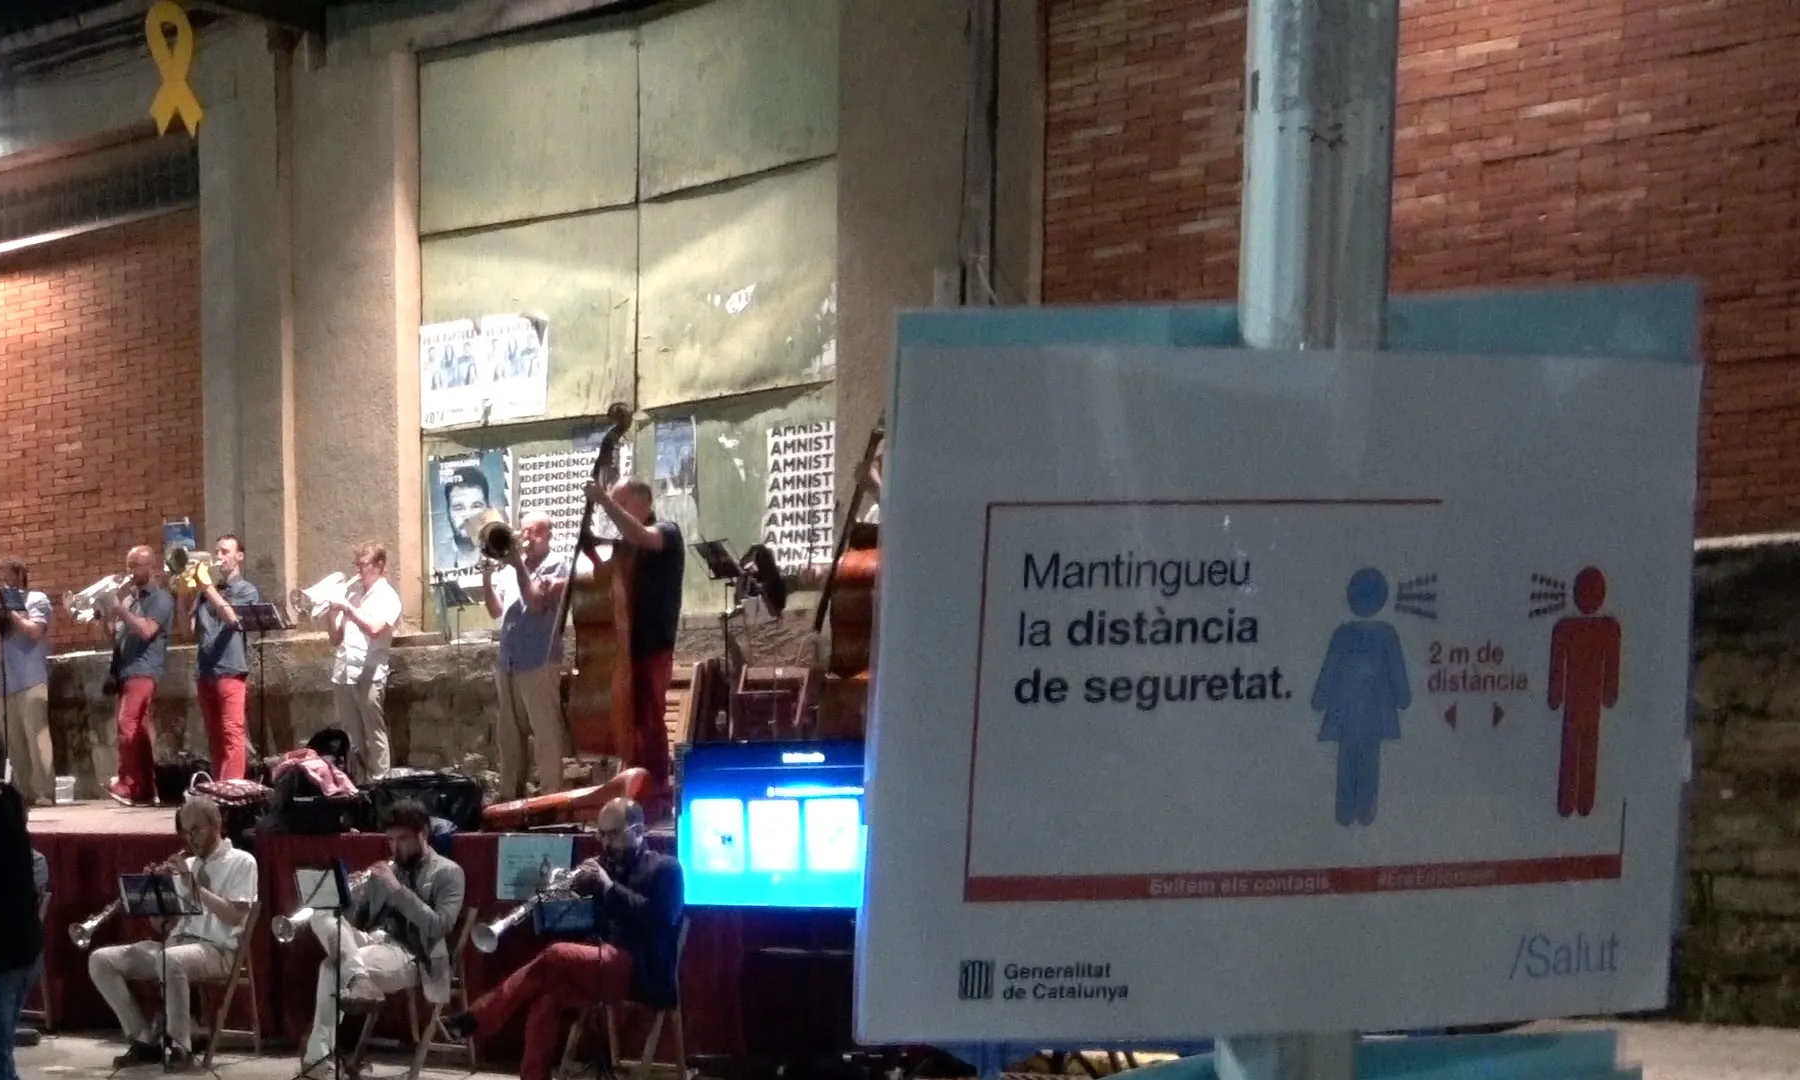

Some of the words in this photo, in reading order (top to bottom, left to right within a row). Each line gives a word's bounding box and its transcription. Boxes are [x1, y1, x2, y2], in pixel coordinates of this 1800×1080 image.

[770, 435, 833, 456] AMNIST
[769, 454, 833, 473] AMNIST
[768, 472, 833, 492] AMNIST
[767, 490, 833, 509] AMNIST
[765, 508, 833, 526] AMNIST
[764, 526, 833, 545] AMNIST
[1023, 552, 1252, 595] Mantingueu
[1018, 610, 1052, 648] la
[1067, 608, 1259, 648] distància
[1429, 641, 1443, 665] 2
[1448, 646, 1471, 665] m
[1476, 639, 1505, 665] de
[1014, 668, 1068, 705] de
[1084, 669, 1293, 711] seguretat.
[1427, 667, 1529, 694] distància
[1149, 877, 1216, 897] Evitem
[1220, 876, 1249, 894] els
[1003, 962, 1112, 980] Generalitat
[1002, 985, 1027, 1001] de
[1032, 982, 1129, 1002] Catalunya
